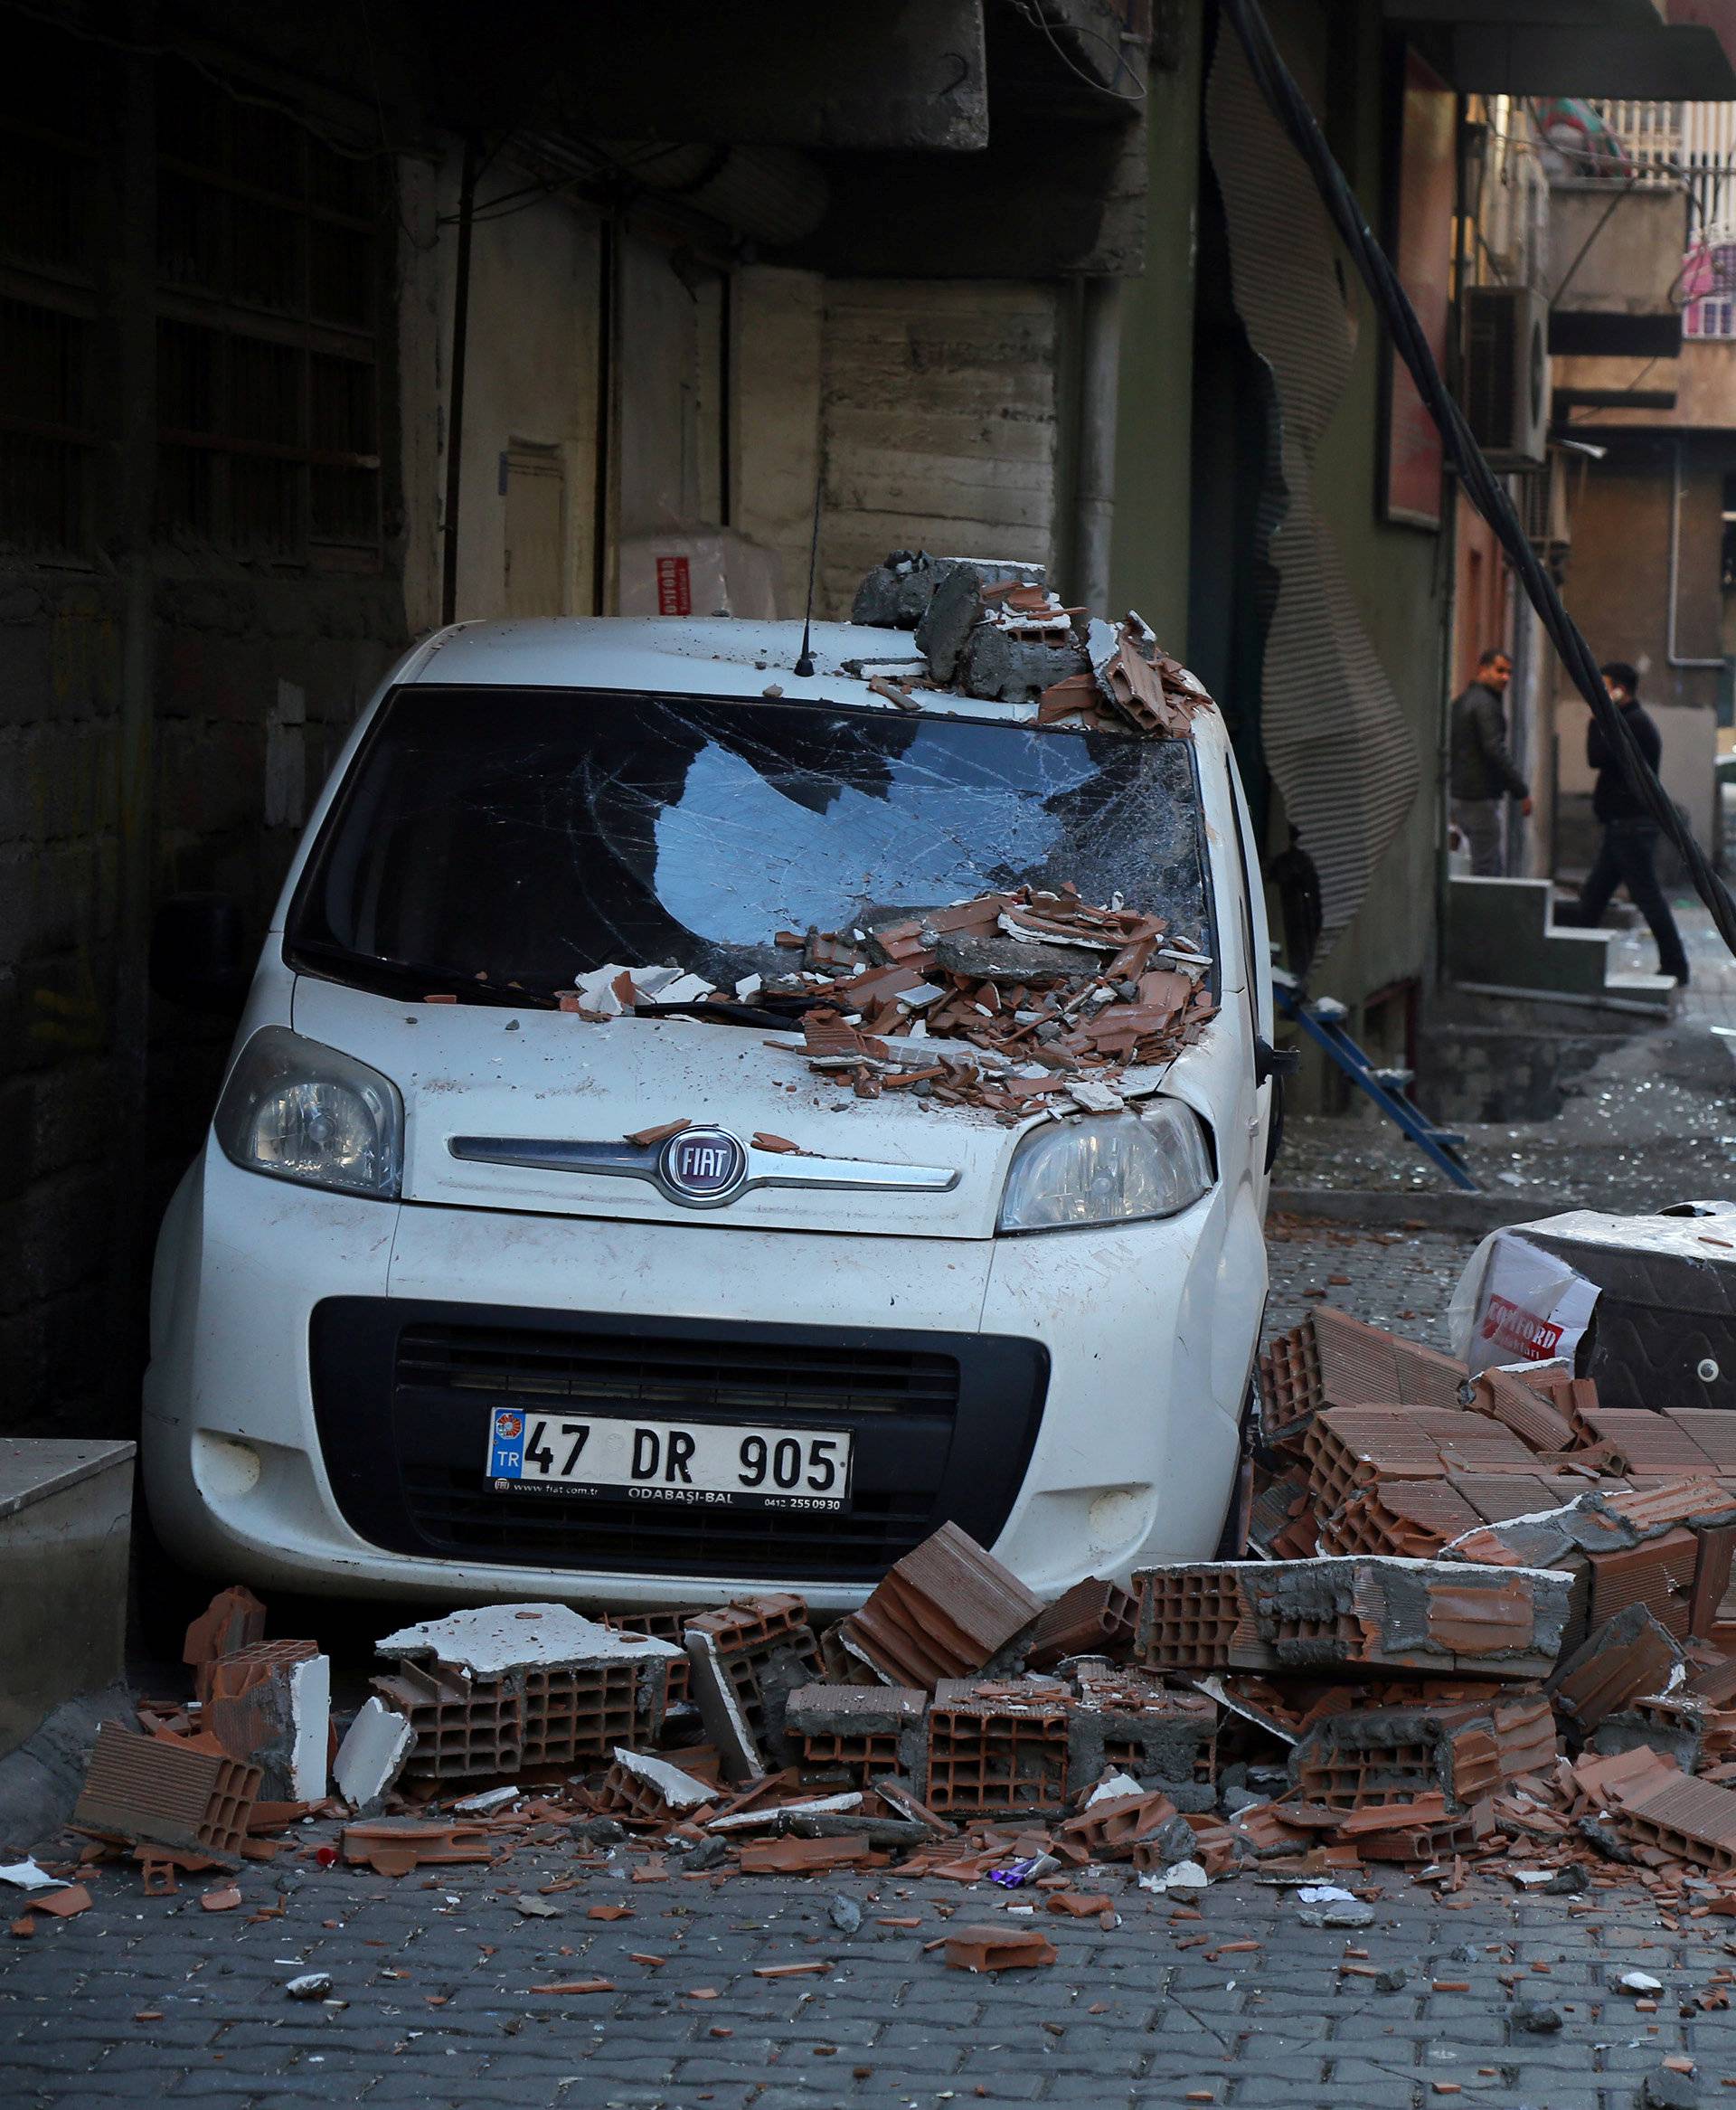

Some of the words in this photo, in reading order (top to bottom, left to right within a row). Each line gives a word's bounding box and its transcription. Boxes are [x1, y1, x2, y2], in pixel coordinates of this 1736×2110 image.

[683, 1147, 727, 1177] FIAT
[497, 1451, 519, 1468] TR
[524, 1421, 590, 1476] 47
[631, 1428, 695, 1483] DR
[738, 1435, 836, 1490] 905
[628, 1488, 733, 1504] ODABAŞI-BAL
